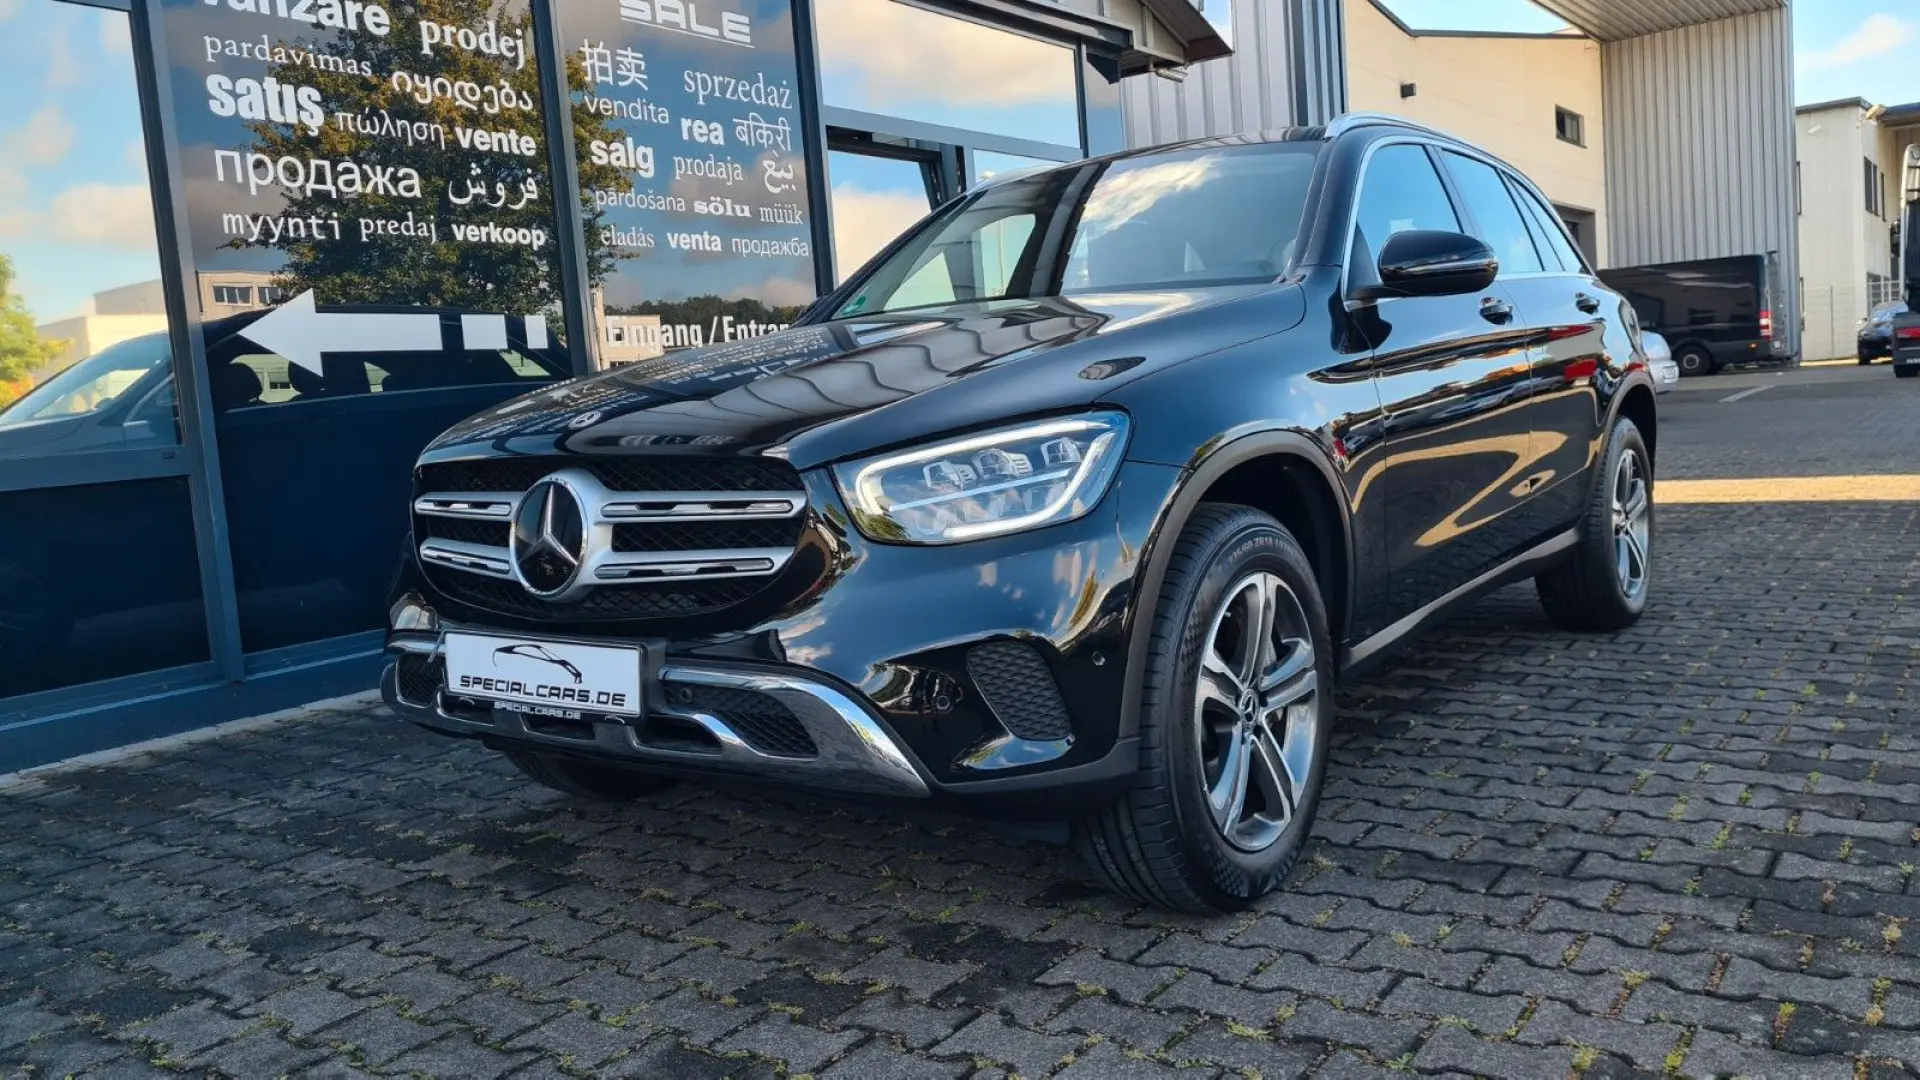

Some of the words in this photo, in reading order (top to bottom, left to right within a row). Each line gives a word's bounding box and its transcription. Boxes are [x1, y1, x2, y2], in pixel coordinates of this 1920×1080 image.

[204, 0, 390, 36] nzare
[620, 0, 751, 43] SALE
[203, 35, 372, 77] pardavimas
[418, 19, 525, 70] prodej
[581, 38, 649, 91] 拍卖
[205, 74, 325, 137] satış
[391, 71, 534, 113] იყიდება
[683, 69, 793, 109] sprzedaż
[584, 95, 670, 124] vendita
[335, 107, 445, 150] πώληση
[455, 126, 536, 156] vente
[680, 117, 725, 146] rea
[214, 149, 422, 199] продажа
[590, 137, 655, 178] salg
[672, 154, 744, 186] prodaja
[448, 162, 540, 210] فروش
[693, 196, 753, 218] sölu
[759, 203, 804, 225] müük
[221, 211, 342, 243] myynti
[359, 210, 437, 244] predaj
[451, 222, 546, 250] verkoop
[601, 225, 656, 248] eladás
[666, 230, 723, 251] venta
[731, 238, 810, 258] продажба
[606, 315, 704, 352] Eingang
[460, 675, 626, 706] SPECIALCARS.DE
[494, 702, 581, 720] SPECIALCARS.DE
